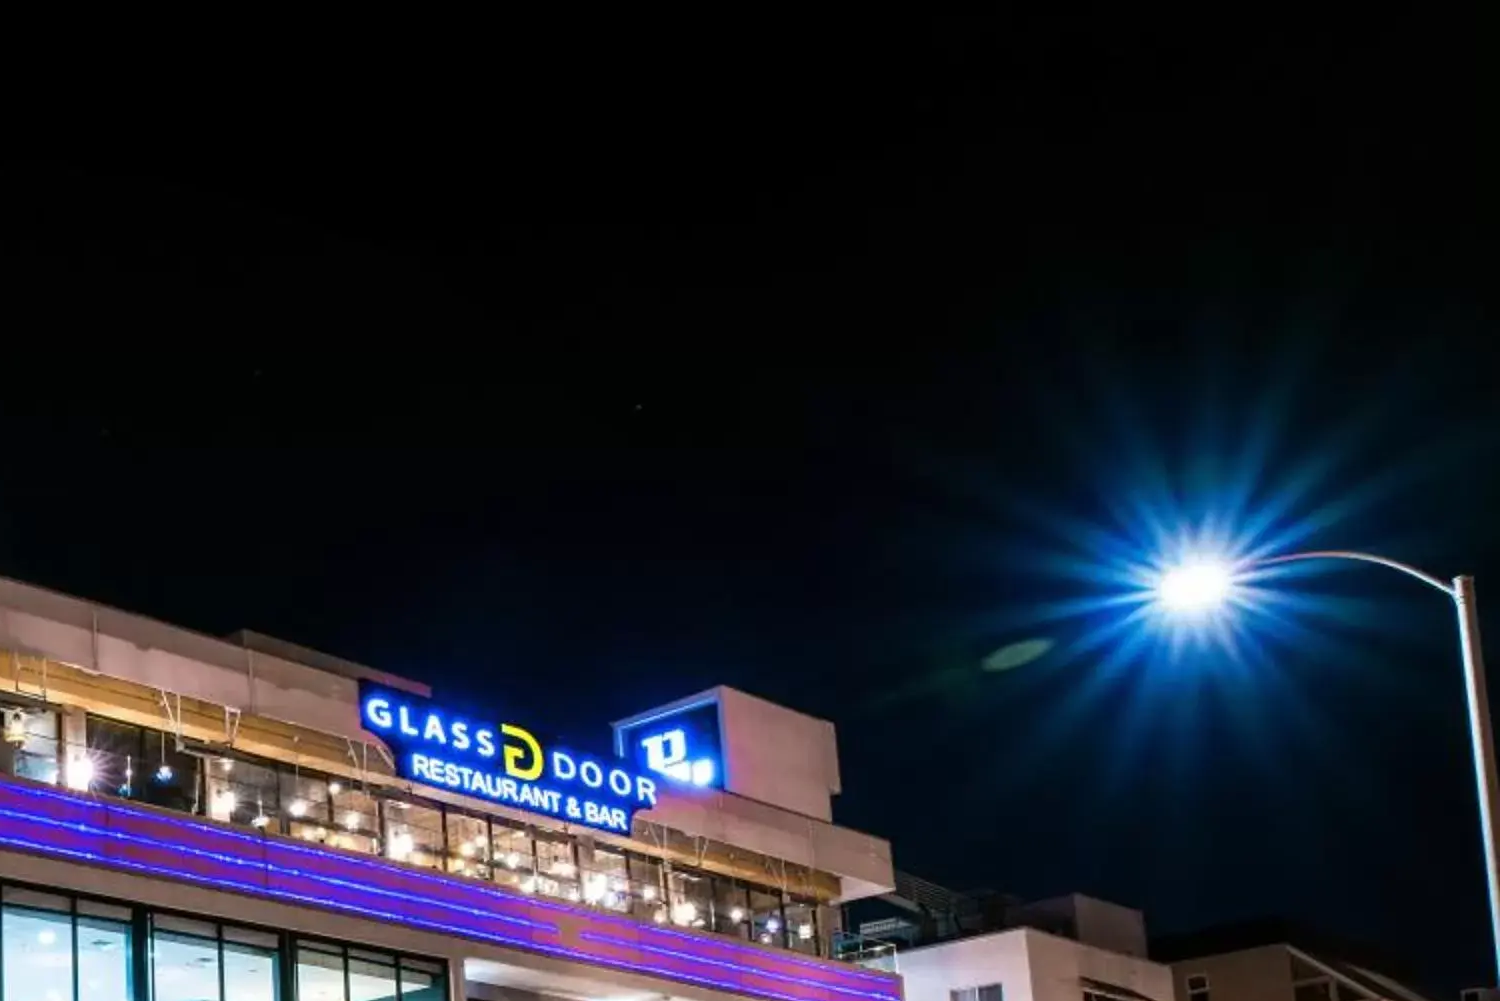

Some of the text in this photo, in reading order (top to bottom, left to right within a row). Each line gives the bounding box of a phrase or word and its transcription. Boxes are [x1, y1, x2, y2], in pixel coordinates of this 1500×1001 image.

[366, 698, 495, 757] GLASS
[553, 751, 656, 804] DOOR
[411, 753, 629, 830] RESTAURANT & BAR
